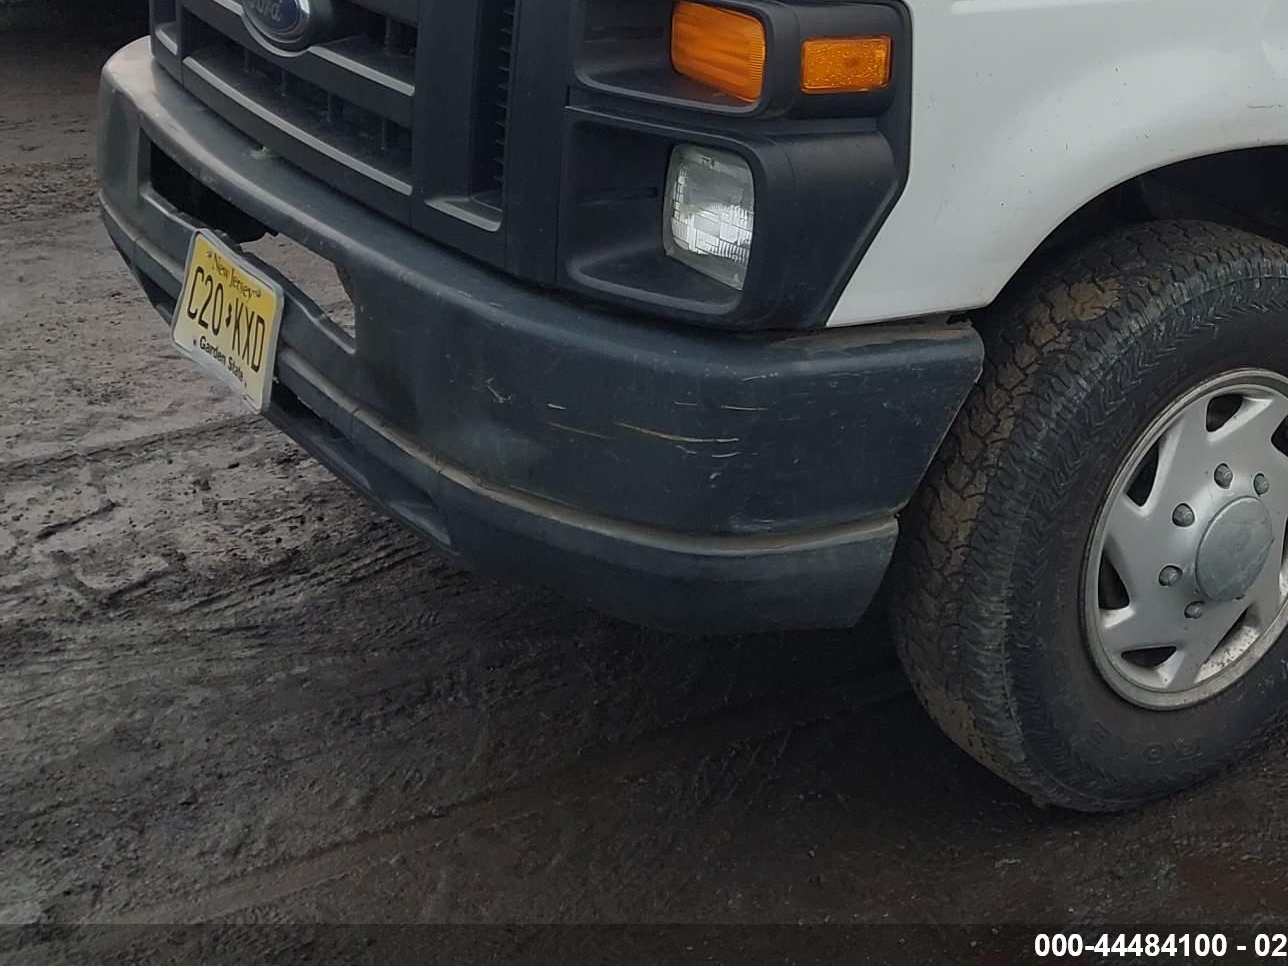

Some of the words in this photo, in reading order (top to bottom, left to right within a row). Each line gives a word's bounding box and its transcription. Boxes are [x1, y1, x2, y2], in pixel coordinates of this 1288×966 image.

[212, 254, 229, 280] New
[228, 267, 252, 300] Jersey
[199, 335, 227, 366] Garden
[227, 356, 244, 382] State
